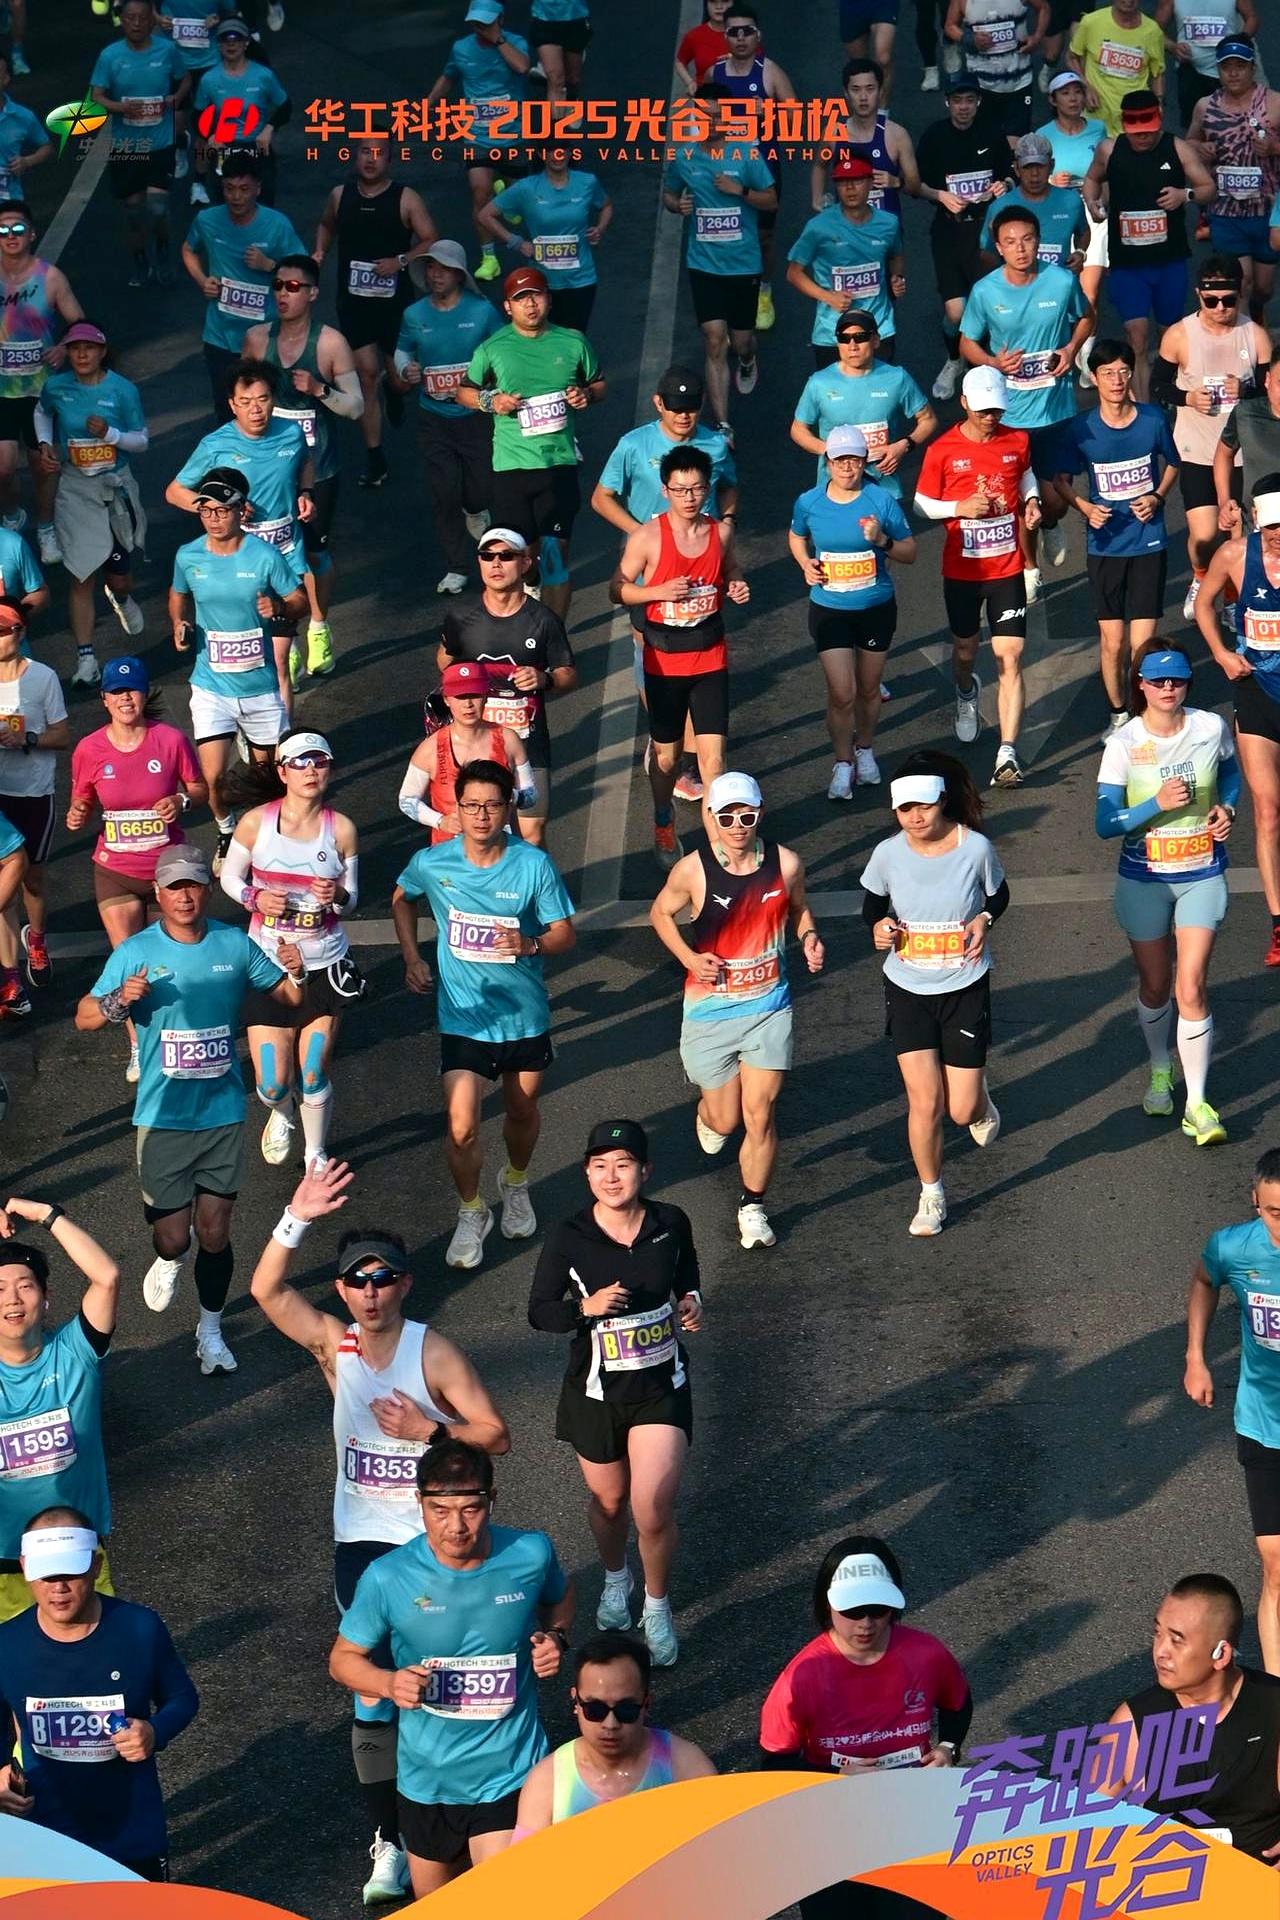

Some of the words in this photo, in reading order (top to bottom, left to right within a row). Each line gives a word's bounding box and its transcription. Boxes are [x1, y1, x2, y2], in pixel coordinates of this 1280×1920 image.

[992, 30, 1014, 42] 269
[1195, 24, 1225, 36] 2617
[1111, 54, 1142, 70] 3630
[1227, 174, 1260, 188] 3962
[707, 216, 739, 229] 2640
[1134, 219, 1165, 232] 1951
[846, 272, 878, 287] 2481
[231, 291, 265, 307] 0158
[7, 351, 41, 363] 2536
[532, 401, 567, 420] 3508
[1098, 473, 1108, 493] B
[1111, 467, 1150, 487] 0482
[963, 529, 972, 549] B
[976, 527, 1013, 544] 0483
[834, 561, 873, 578] 6503
[679, 595, 716, 614] 3537
[1258, 621, 1280, 636] 01
[210, 641, 218, 663] B
[222, 640, 261, 657] 2256
[105, 821, 117, 843] B
[120, 820, 164, 837] 6650
[1150, 839, 1161, 862] A
[1166, 835, 1209, 854] 6735
[451, 922, 461, 946] B
[913, 934, 960, 951] 6416
[732, 963, 776, 986] 2497
[165, 1042, 177, 1069] B
[182, 1039, 229, 1060] 2306
[1252, 1308, 1265, 1337] B
[603, 1332, 618, 1361] B
[622, 1319, 673, 1351] 7094
[9, 1425, 70, 1458] 1595
[347, 1449, 357, 1481] B
[361, 1456, 418, 1480] 1353
[495, 1591, 525, 1605] SILVA
[443, 1660, 478, 1668] HGTECH
[447, 1672, 512, 1695] 3597
[48, 1700, 83, 1709] HGTECH
[31, 1714, 47, 1746] B
